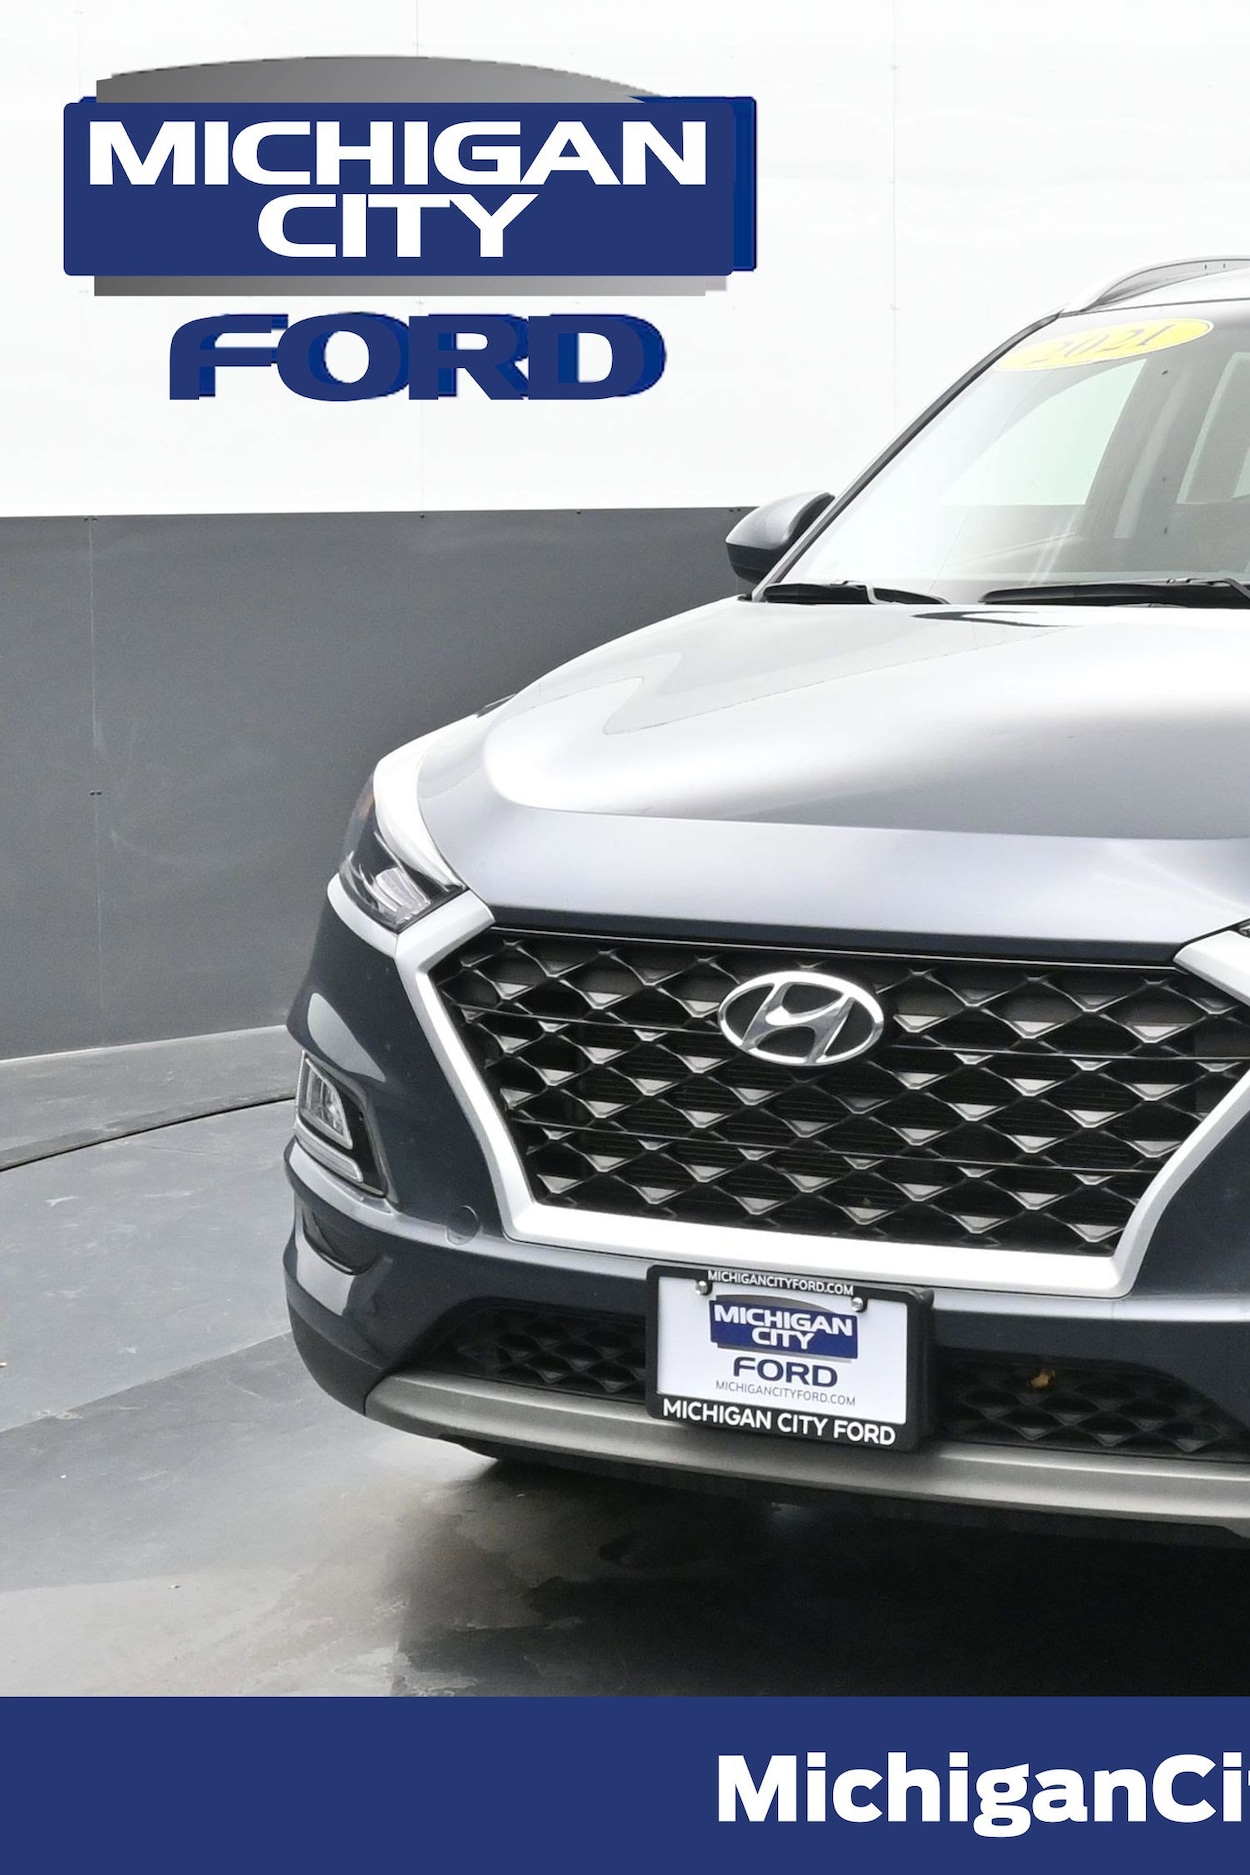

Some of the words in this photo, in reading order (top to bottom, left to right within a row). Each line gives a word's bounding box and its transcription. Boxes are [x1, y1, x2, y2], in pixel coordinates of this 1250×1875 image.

[1022, 323, 1176, 367] 2021
[707, 1269, 855, 1297] MICHIGANCITYFORD.COM
[714, 1304, 853, 1336] MICHIGAN
[751, 1327, 815, 1350] CITY
[733, 1356, 838, 1388] FORD
[715, 1380, 856, 1407] MICHIGANCITYFORD.COM
[663, 1398, 772, 1430] MICHIGAN
[777, 1412, 828, 1437] CITY
[833, 1420, 896, 1446] FORD
